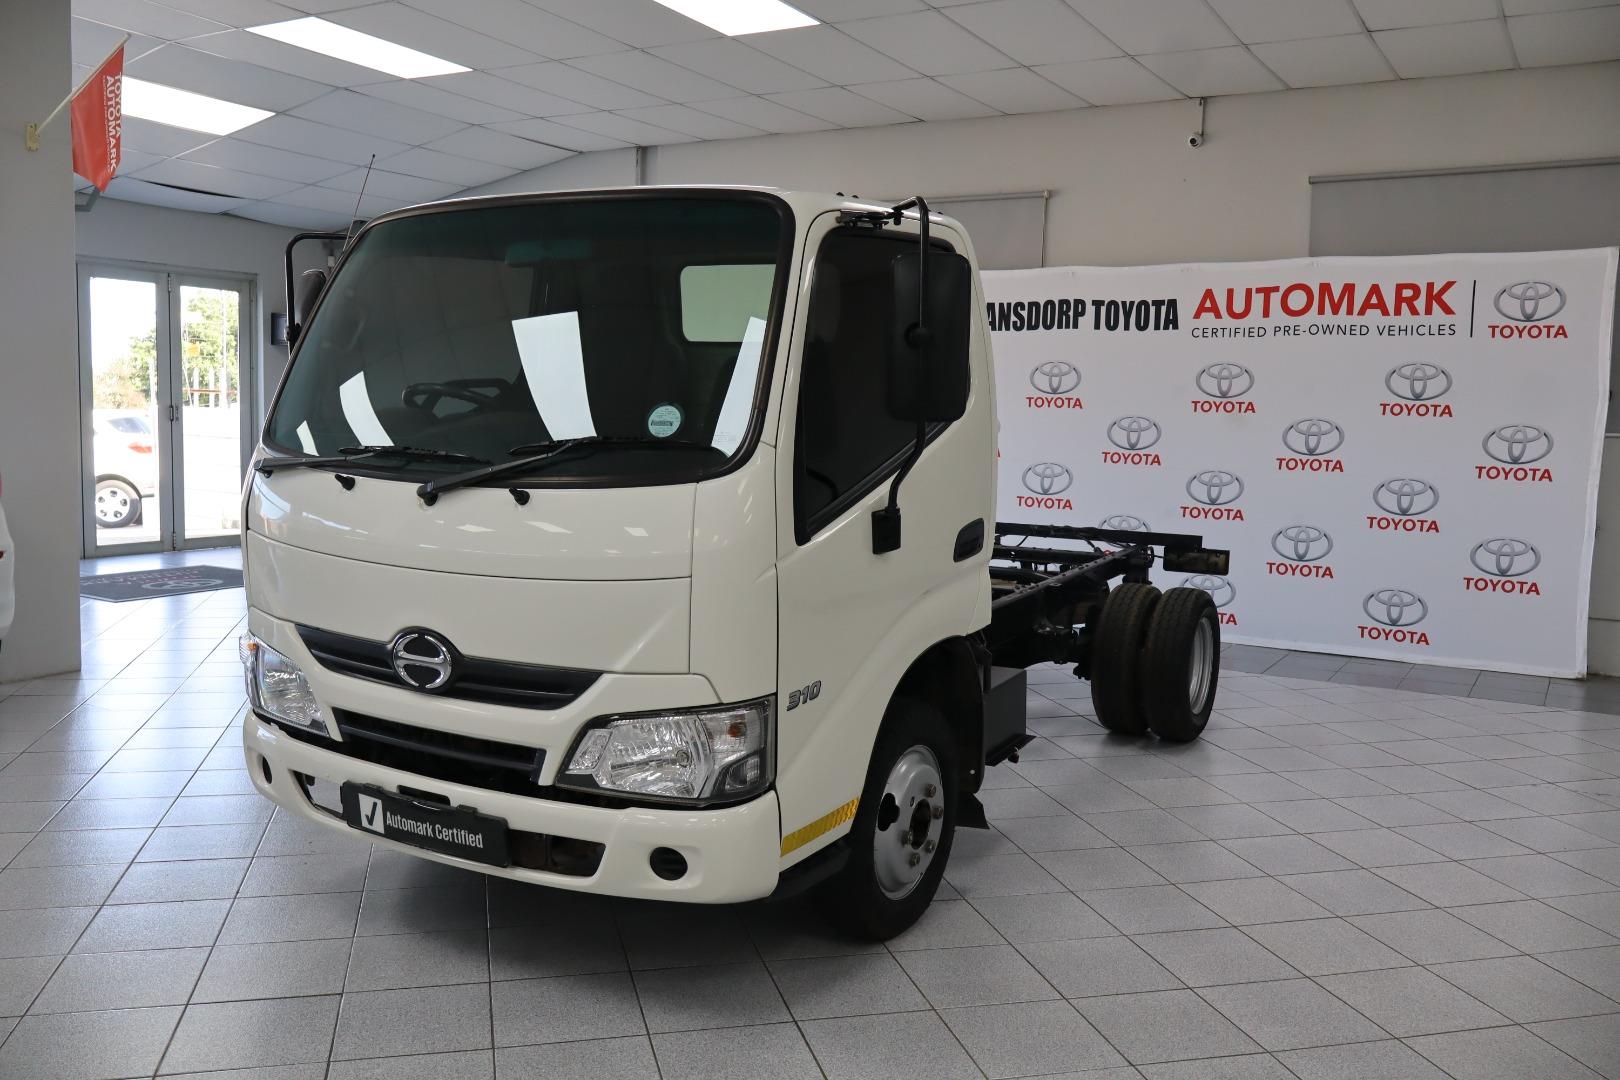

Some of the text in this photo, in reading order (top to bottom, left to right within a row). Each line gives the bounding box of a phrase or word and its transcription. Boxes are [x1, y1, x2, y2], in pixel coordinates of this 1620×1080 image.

[106, 75, 117, 173] AUTOMARK
[1192, 280, 1457, 321] AUTOMARK
[986, 298, 1179, 332] ANSDORP TOYOTA
[1191, 323, 1457, 338] CERTIFIED PRE-OWNED VEHICLES
[1489, 323, 1568, 341] TOYOTA
[1027, 396, 1083, 409] TOYOTA
[1192, 400, 1257, 414] TOYOTA
[1381, 401, 1453, 416] TOYOTA
[1104, 451, 1161, 464] TOYOTA
[1279, 457, 1344, 472] TOYOTA
[1477, 464, 1552, 481] TOYOTA
[1018, 496, 1072, 509] TOYOTA
[1182, 507, 1244, 520] TOYOTA
[1368, 516, 1440, 532] TOYOTA
[1268, 561, 1333, 577] TOYOTA
[1465, 576, 1540, 596] TOYOTA
[1358, 625, 1430, 645] TOYOTA
[786, 680, 822, 711] 310
[386, 810, 484, 849] Automark Certified
